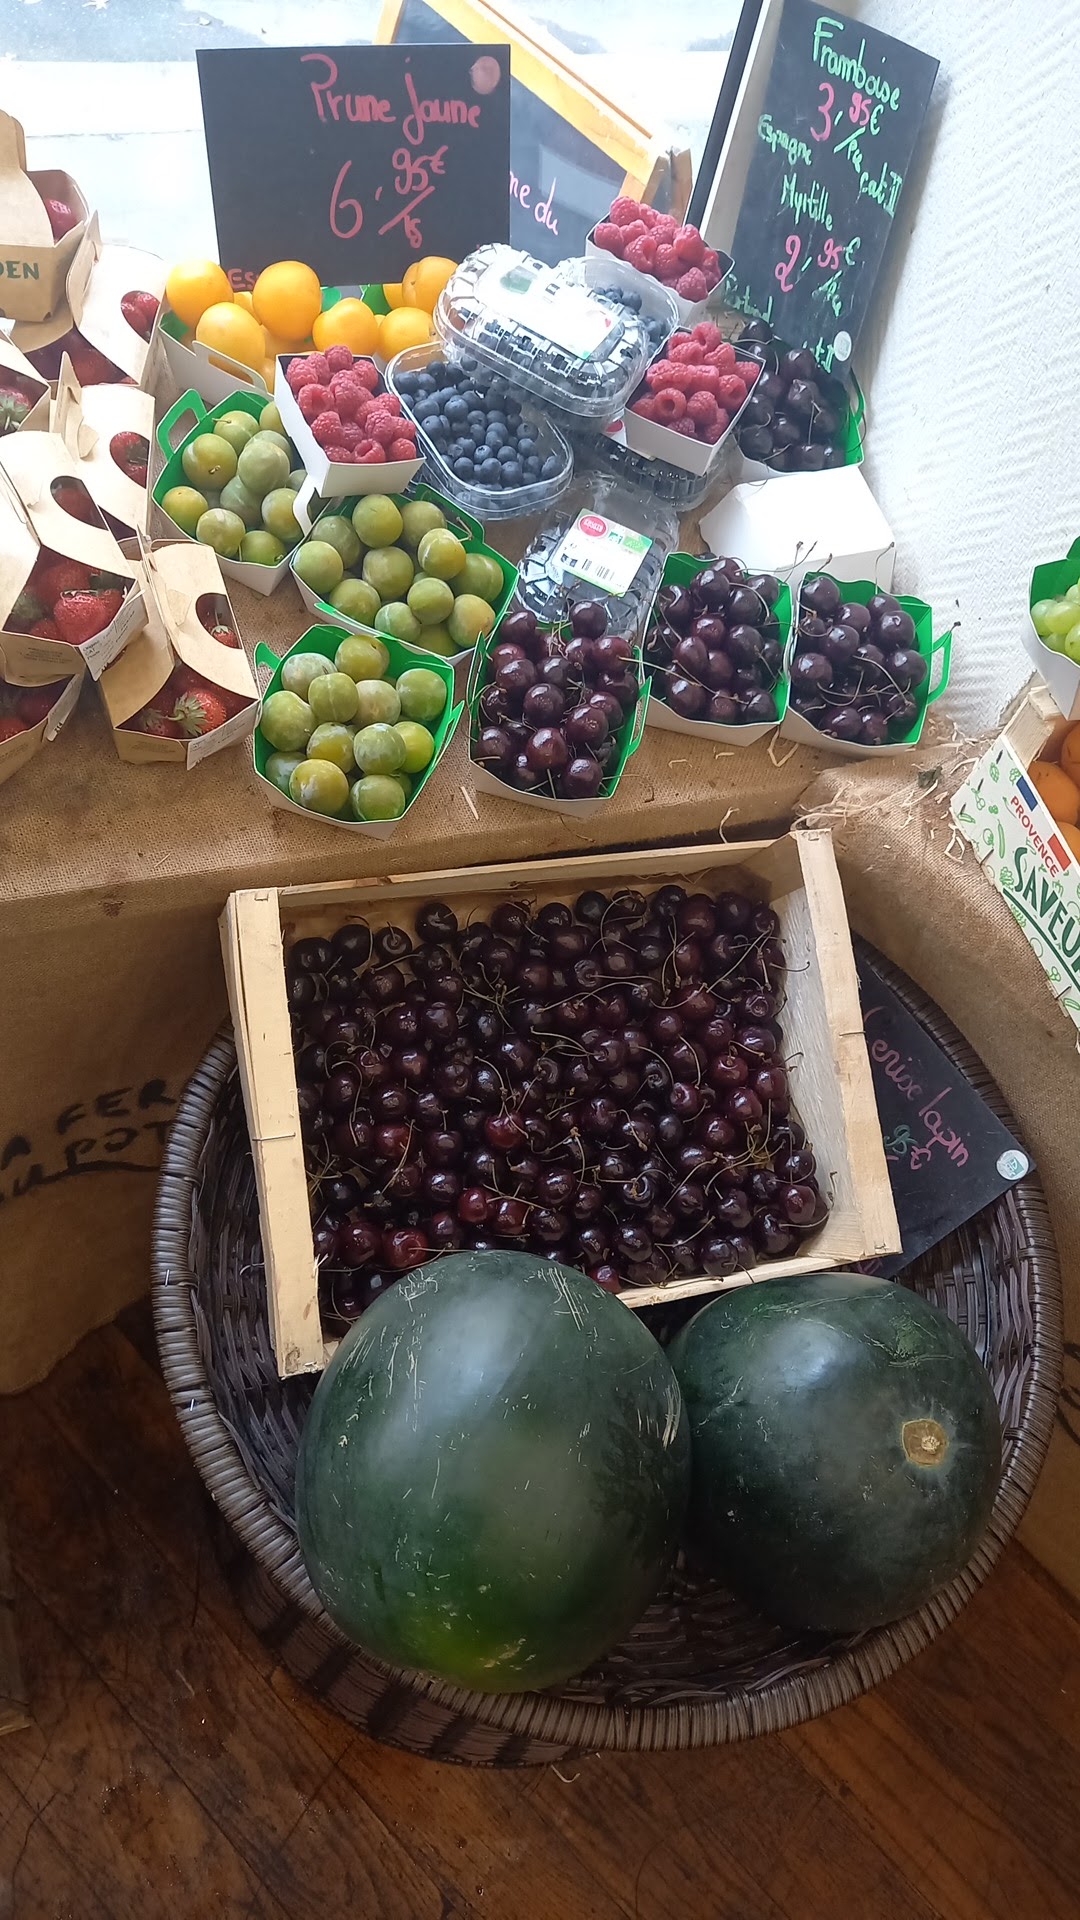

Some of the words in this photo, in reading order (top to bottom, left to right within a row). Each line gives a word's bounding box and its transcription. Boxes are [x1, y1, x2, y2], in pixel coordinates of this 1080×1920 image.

[300, 53, 396, 123] Prune
[402, 56, 481, 145] jaune
[813, 17, 900, 111] Framboise
[758, 114, 812, 165] Espagne
[510, 171, 531, 208] ne
[535, 177, 558, 235] du
[781, 172, 833, 231] Myrtille
[1010, 796, 1059, 878] PROVENCE
